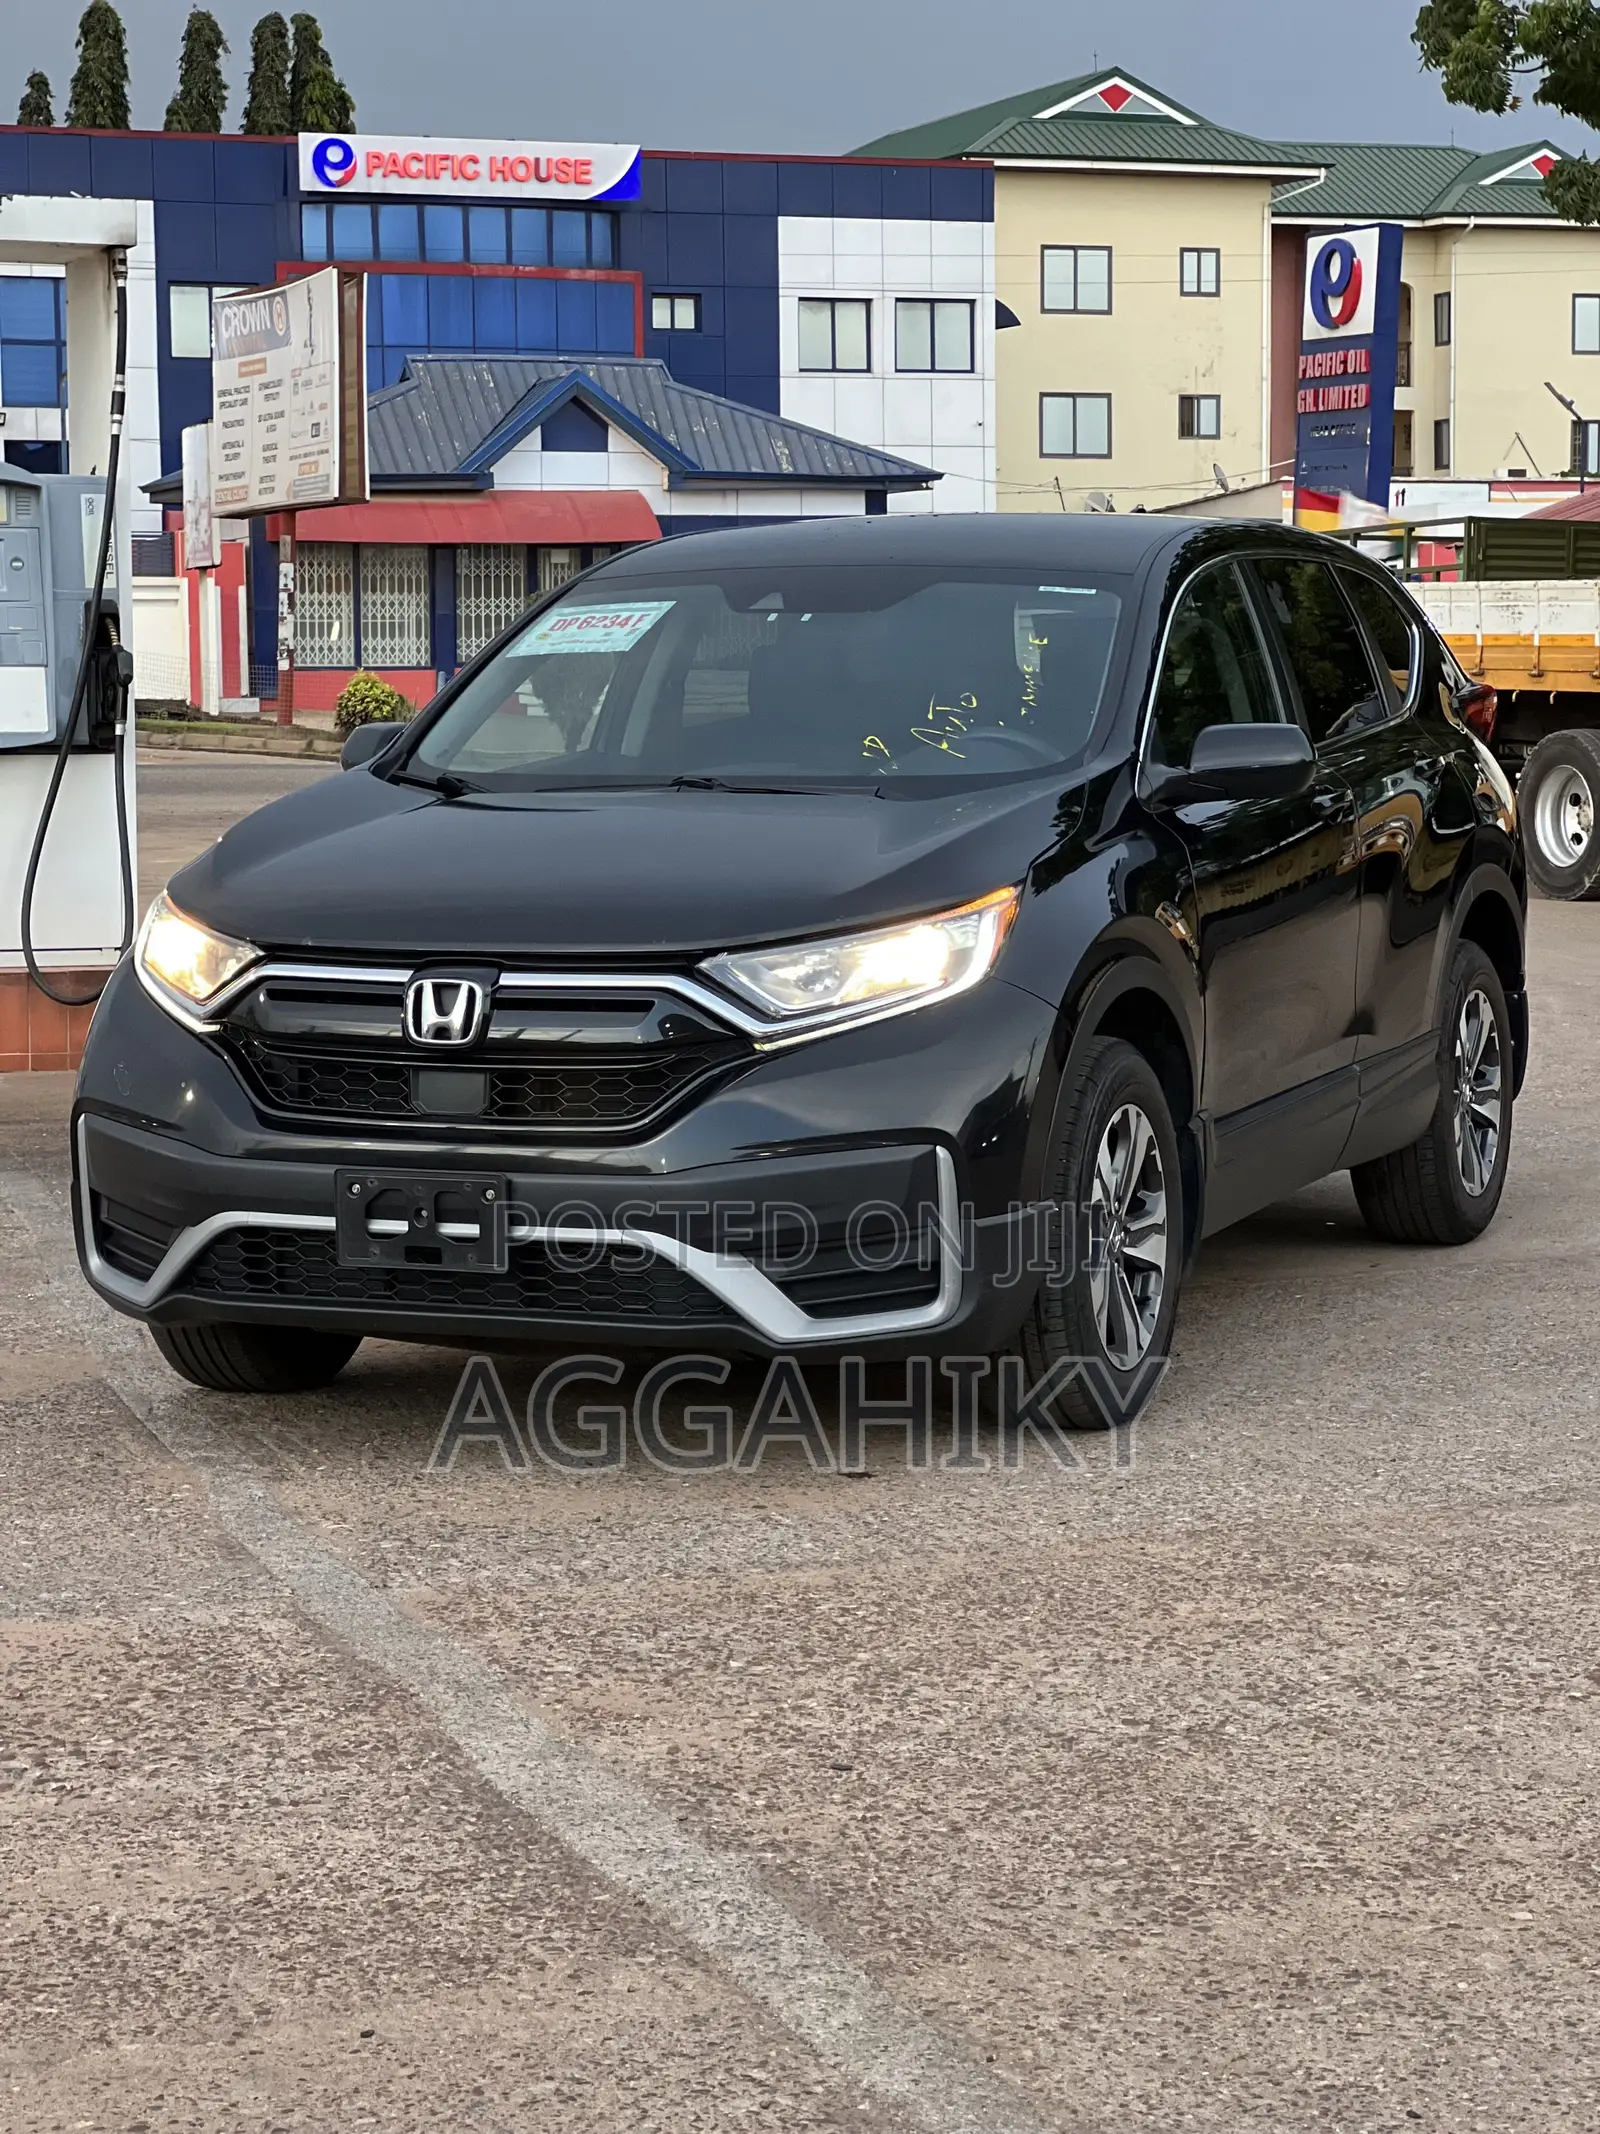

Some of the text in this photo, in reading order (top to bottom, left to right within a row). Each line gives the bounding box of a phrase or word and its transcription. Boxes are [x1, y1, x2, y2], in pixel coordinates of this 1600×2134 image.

[365, 151, 593, 184] PACIFIC HOUSE
[221, 298, 271, 338] CROWN
[1298, 349, 1370, 379] PACIFIC OIL
[1318, 384, 1370, 411] LIMITED
[1310, 422, 1357, 437] HEAD OFFICE
[548, 618, 580, 632] DP
[576, 614, 630, 630] 6234
